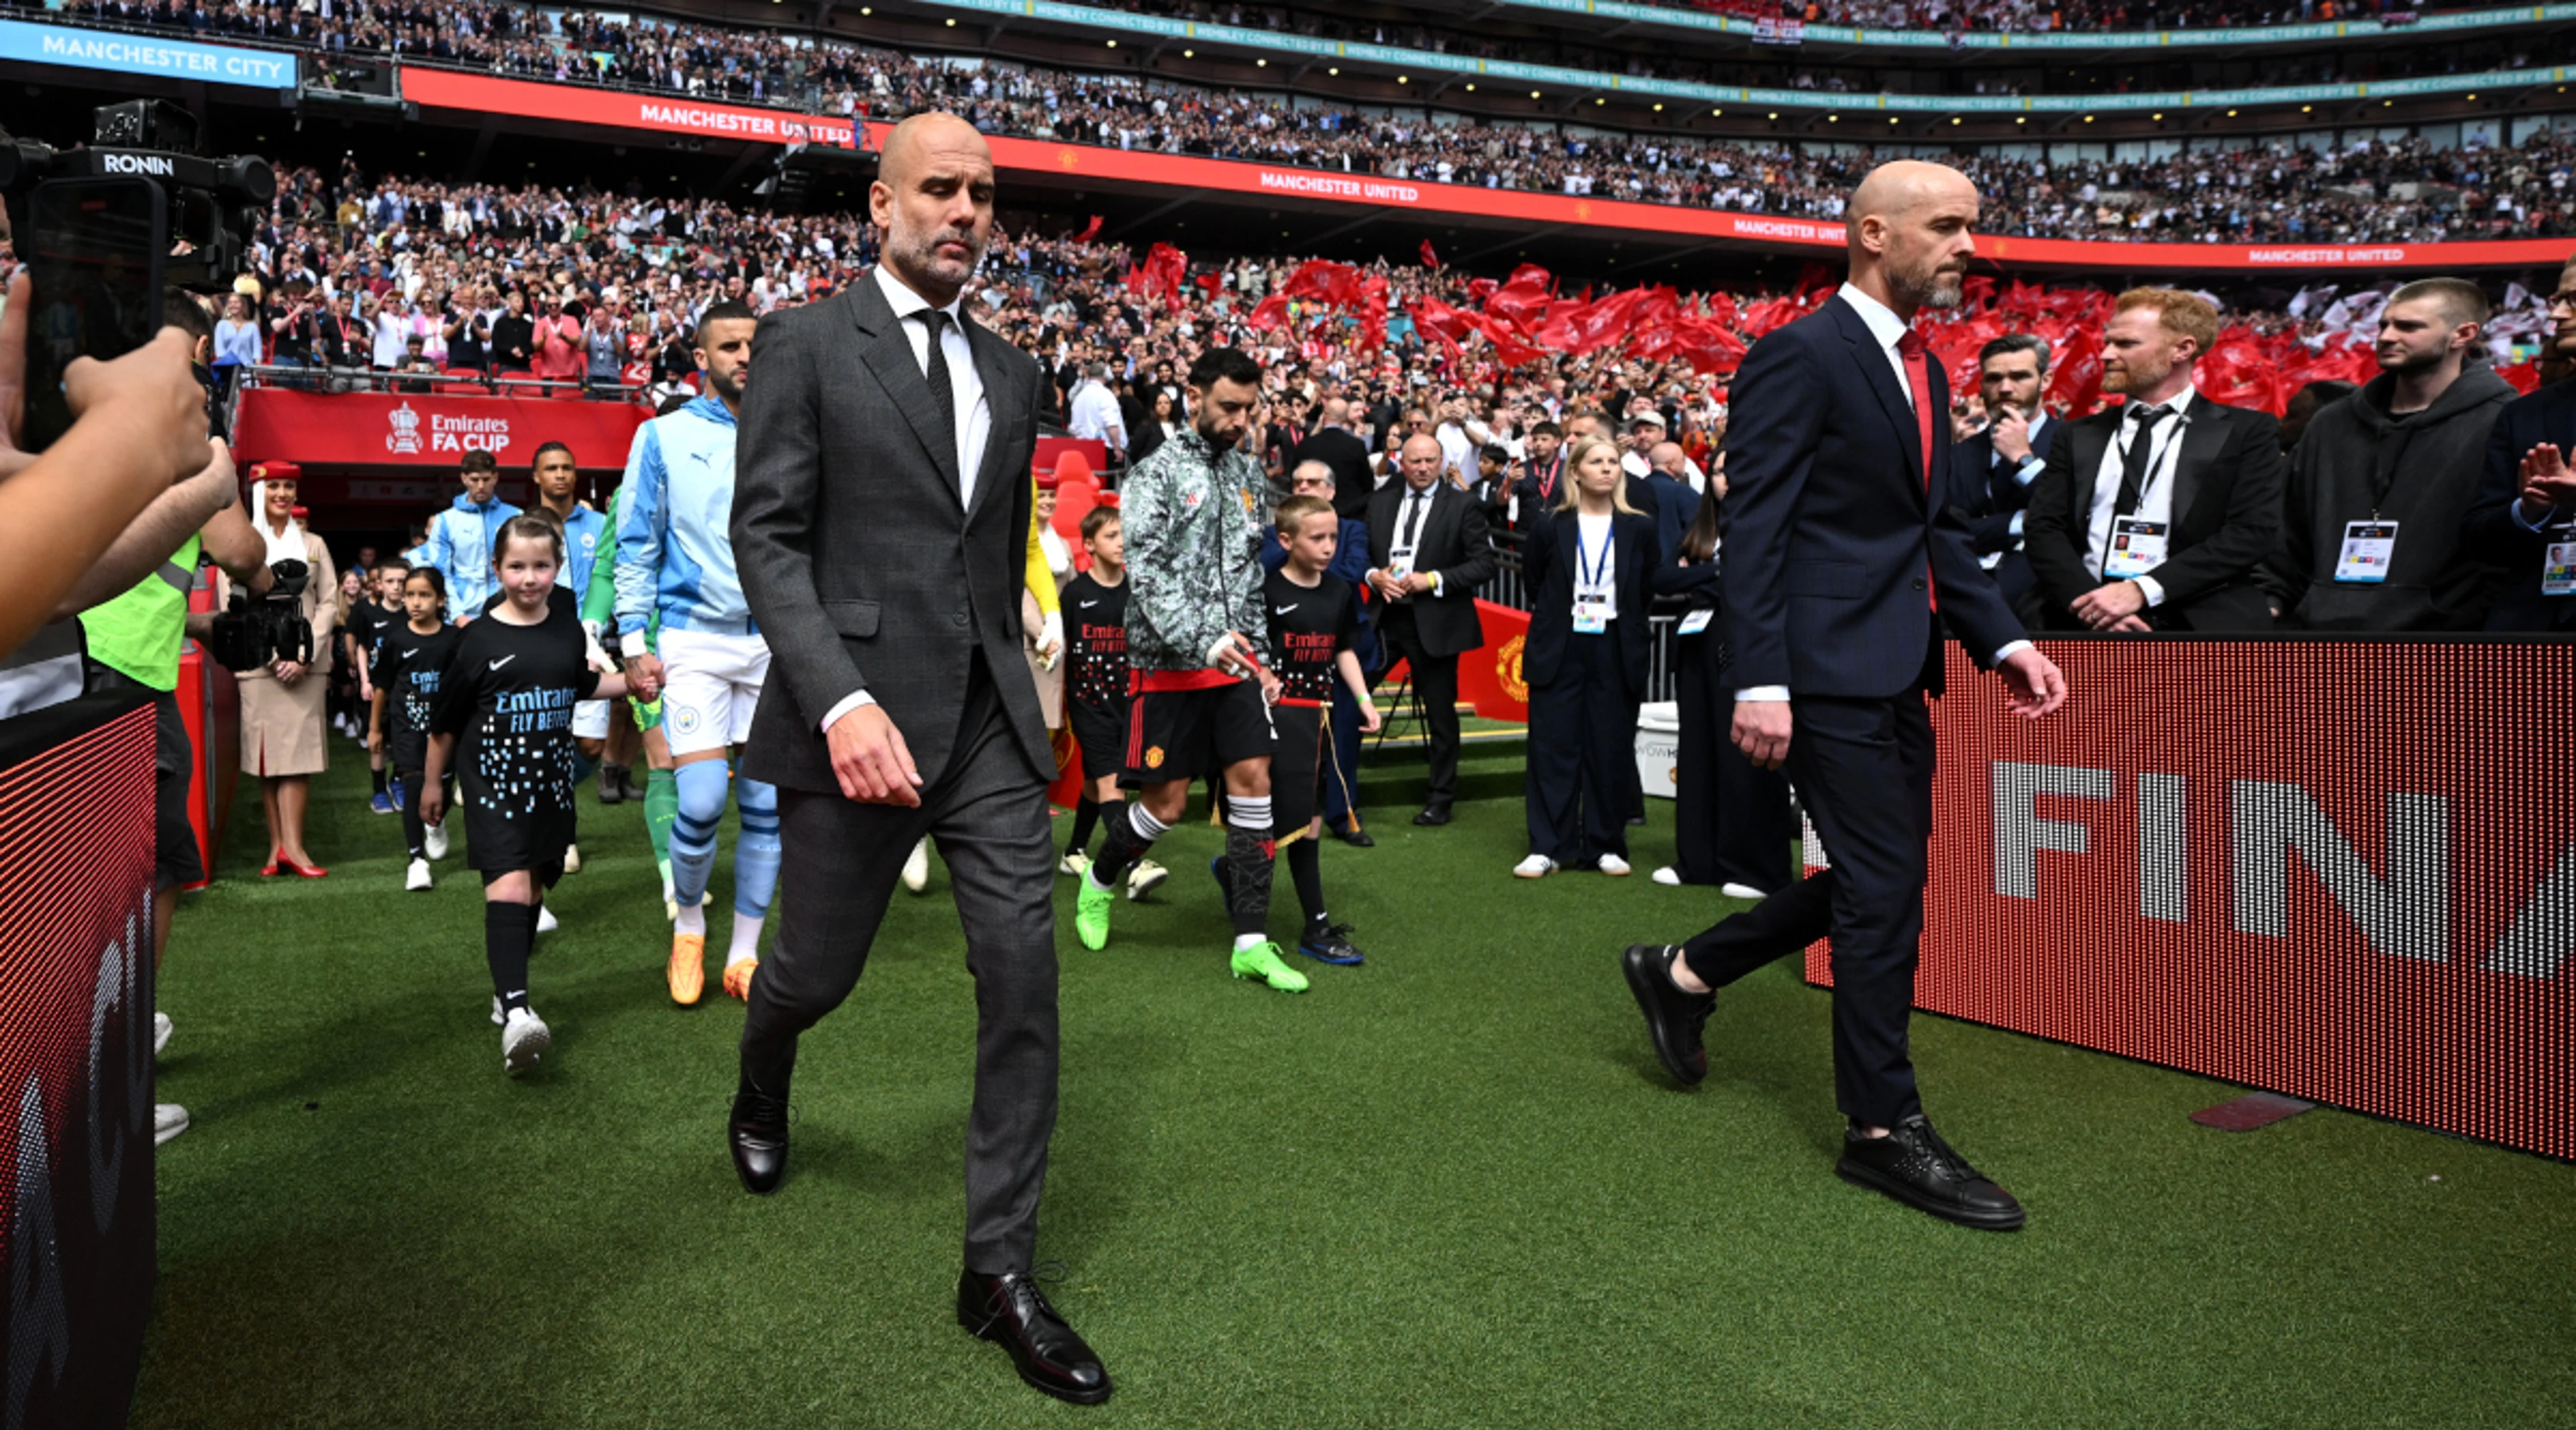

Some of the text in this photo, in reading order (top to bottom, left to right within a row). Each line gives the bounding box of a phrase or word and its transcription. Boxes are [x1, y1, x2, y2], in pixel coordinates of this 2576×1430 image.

[43, 36, 282, 79] MANCHESTER CITY
[641, 104, 851, 143] MANCHESTER UNITED
[103, 154, 174, 176] RONIN
[1261, 172, 1418, 202] MANCHESTER UNITED
[1734, 219, 1847, 241] MANCHESTER UNIT
[2249, 248, 2404, 262] MANCHESTER UNITED
[431, 414, 509, 433] Emirates
[433, 433, 511, 452] FA CUP
[1081, 623, 1125, 639] Emira
[510, 712, 535, 733] FLY
